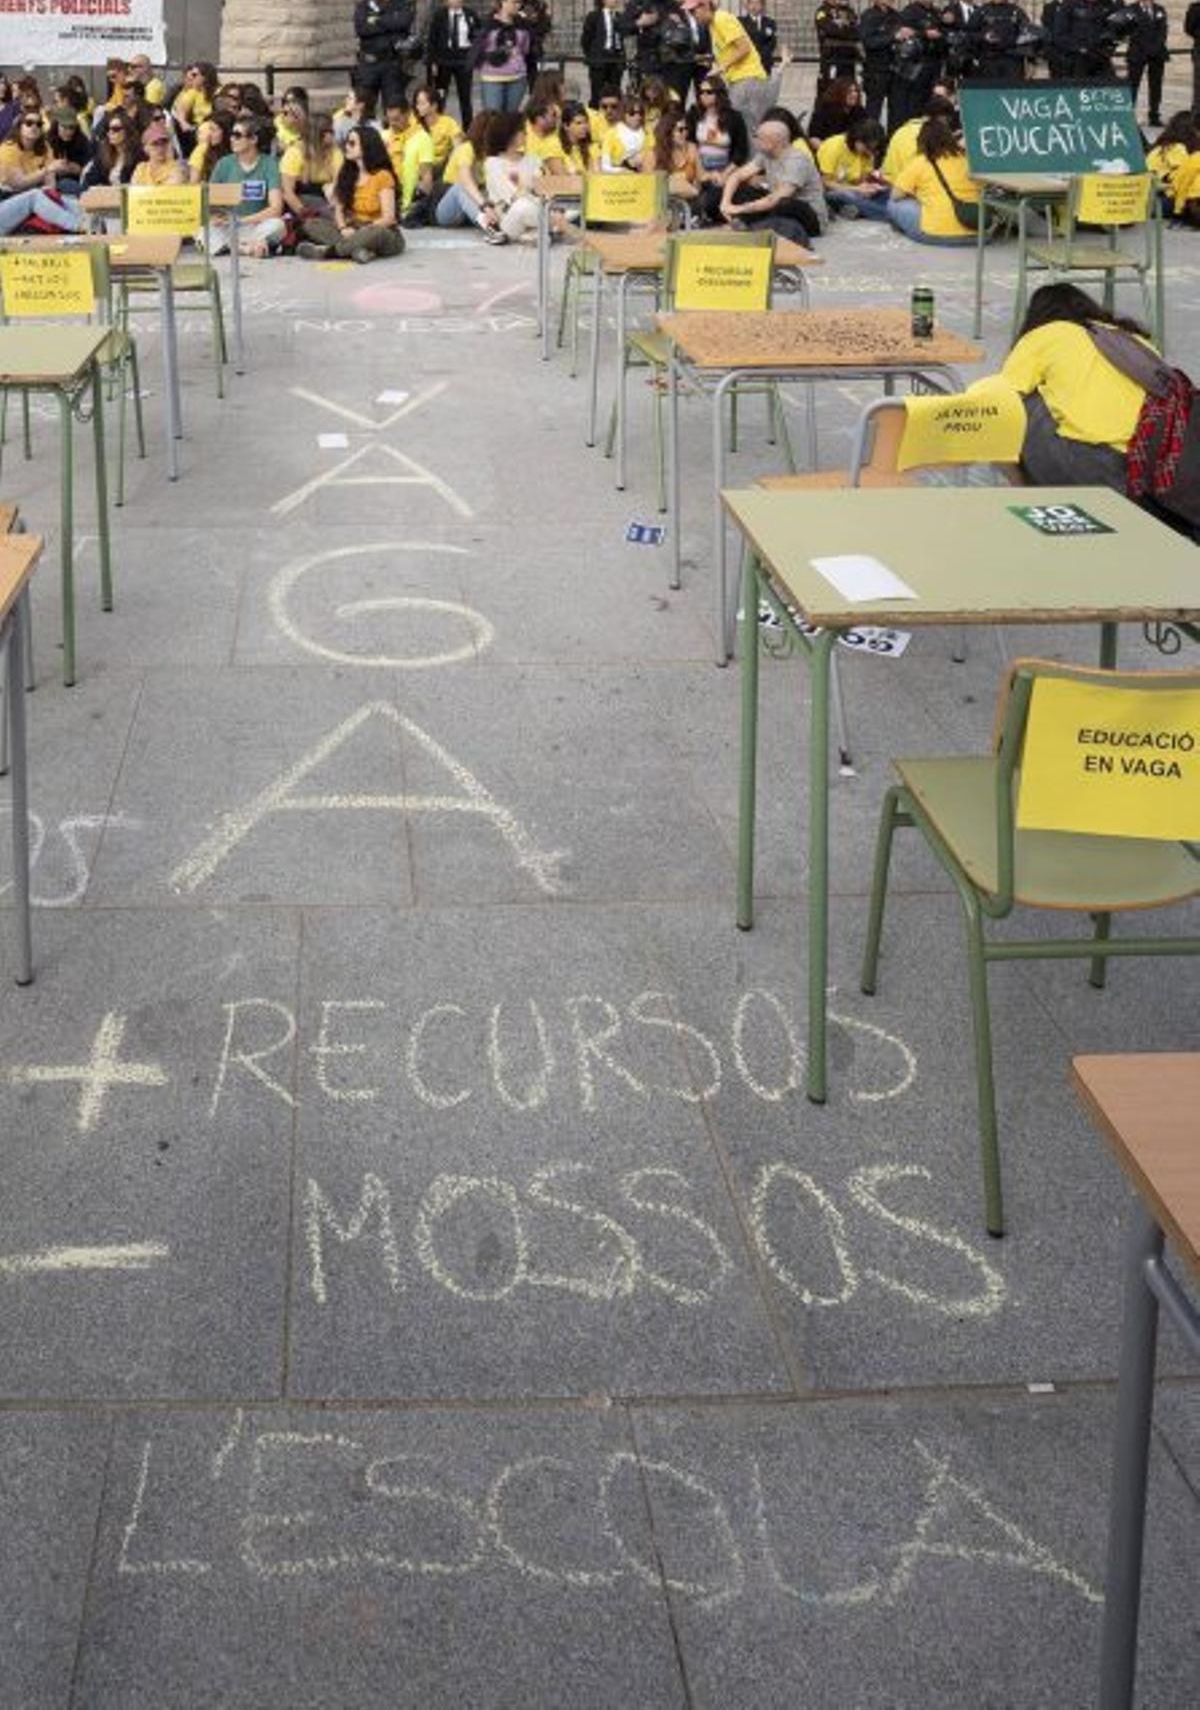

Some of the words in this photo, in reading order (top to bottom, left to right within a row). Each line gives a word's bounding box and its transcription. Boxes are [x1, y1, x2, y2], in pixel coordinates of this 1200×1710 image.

[1001, 93, 1074, 121] VAGA
[1077, 728, 1195, 753] EDUCACIÓ
[1084, 755, 1114, 774] EN
[1121, 757, 1182, 779] VAGA
[207, 986, 918, 1118] RECURSOS
[306, 1162, 1006, 1316] MOSSOS
[117, 1407, 1106, 1610] L'ESCOLA
